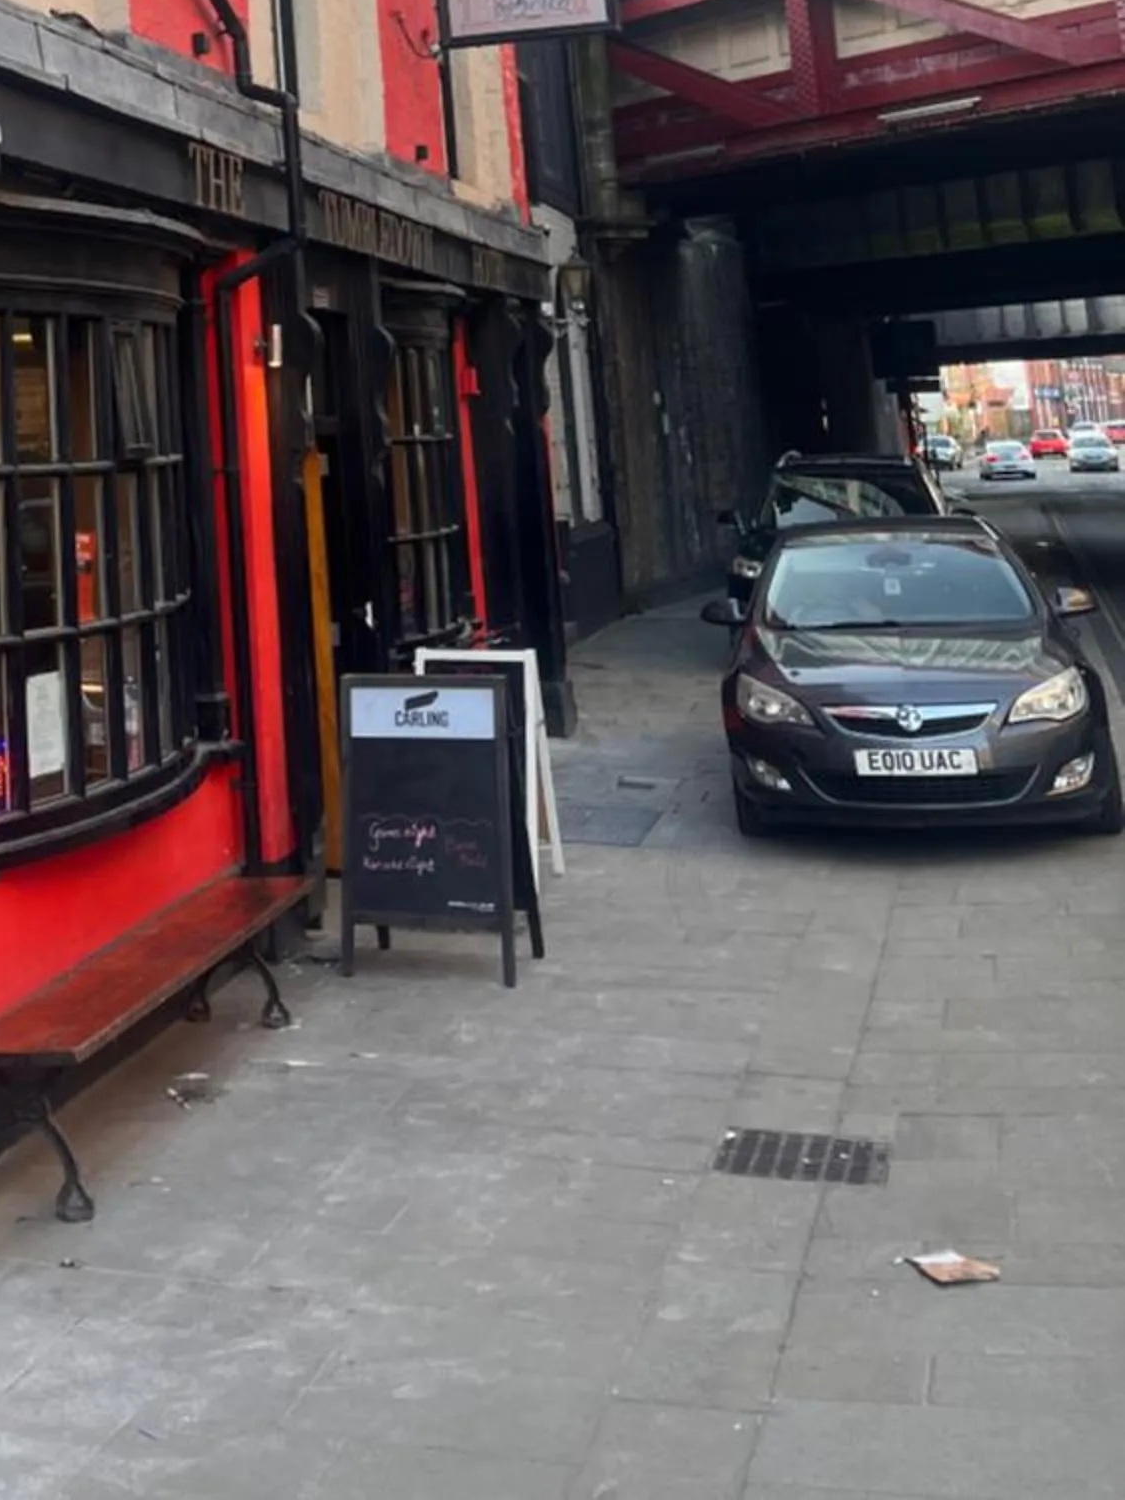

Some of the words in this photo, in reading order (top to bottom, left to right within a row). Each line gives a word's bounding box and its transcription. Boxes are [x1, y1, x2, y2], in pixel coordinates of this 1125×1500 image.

[188, 143, 247, 215] THE
[395, 710, 449, 728] CARLING
[920, 750, 962, 771] UAC
